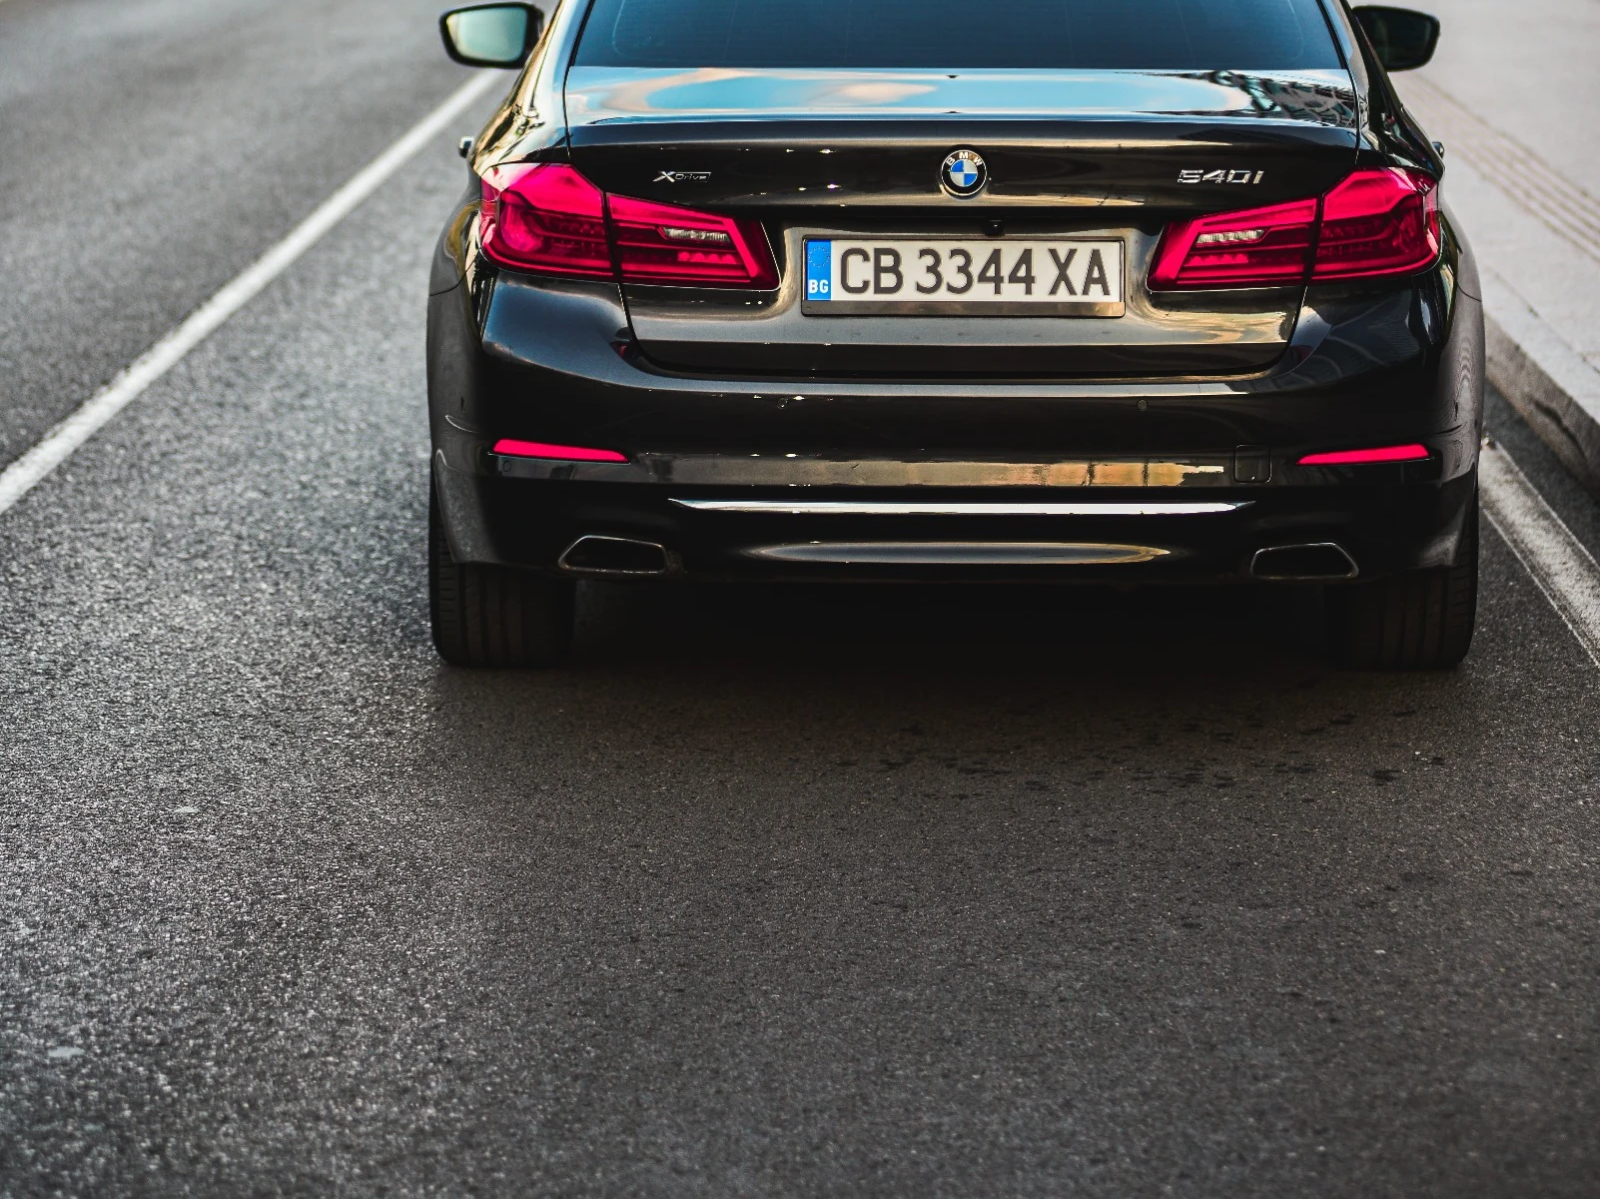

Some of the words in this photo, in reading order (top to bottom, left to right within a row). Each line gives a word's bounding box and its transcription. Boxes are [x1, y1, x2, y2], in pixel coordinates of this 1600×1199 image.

[945, 151, 983, 166] BMW
[840, 247, 904, 294] CB
[916, 248, 1035, 295] 3344
[1048, 248, 1111, 296] XA
[808, 279, 829, 294] BG
